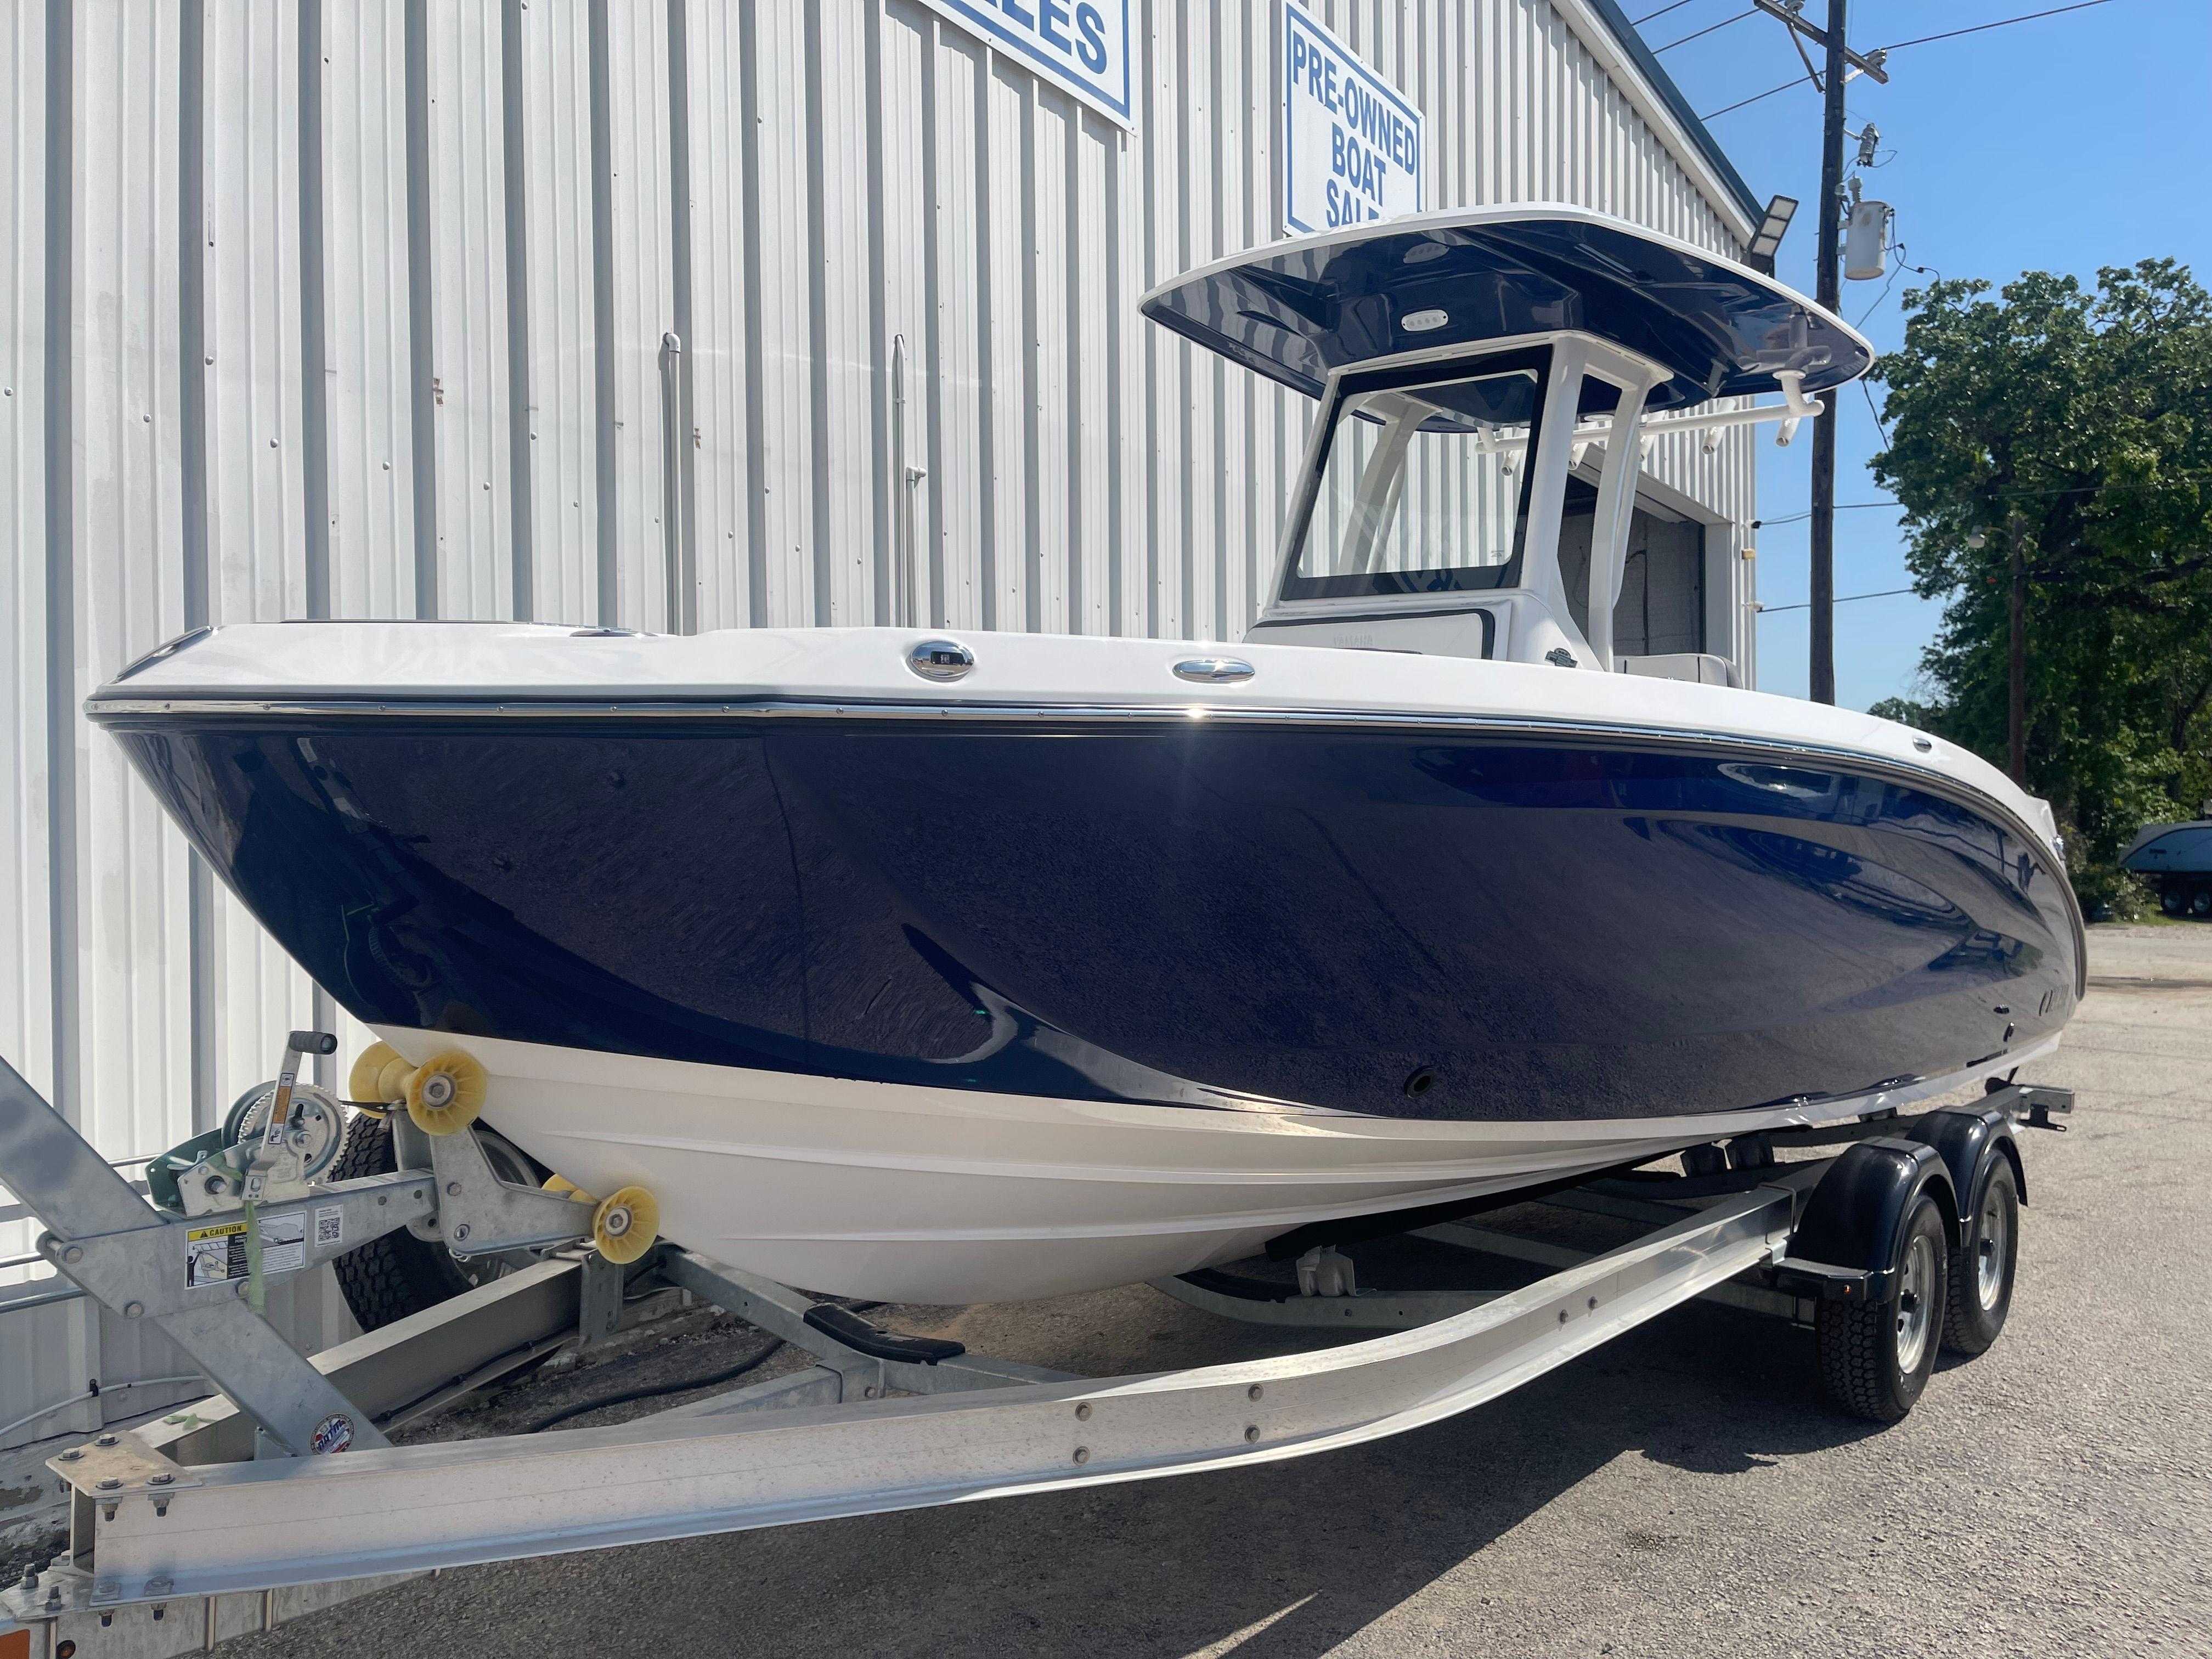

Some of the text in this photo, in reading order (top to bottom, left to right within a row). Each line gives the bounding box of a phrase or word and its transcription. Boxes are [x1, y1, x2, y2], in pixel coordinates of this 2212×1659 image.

[987, 0, 1107, 75] ES
[1293, 30, 1415, 176] PRE-OWNED
[1332, 122, 1386, 207] BOAT
[1326, 179, 1379, 228] SA
[210, 1225, 242, 1236] CAUTION
